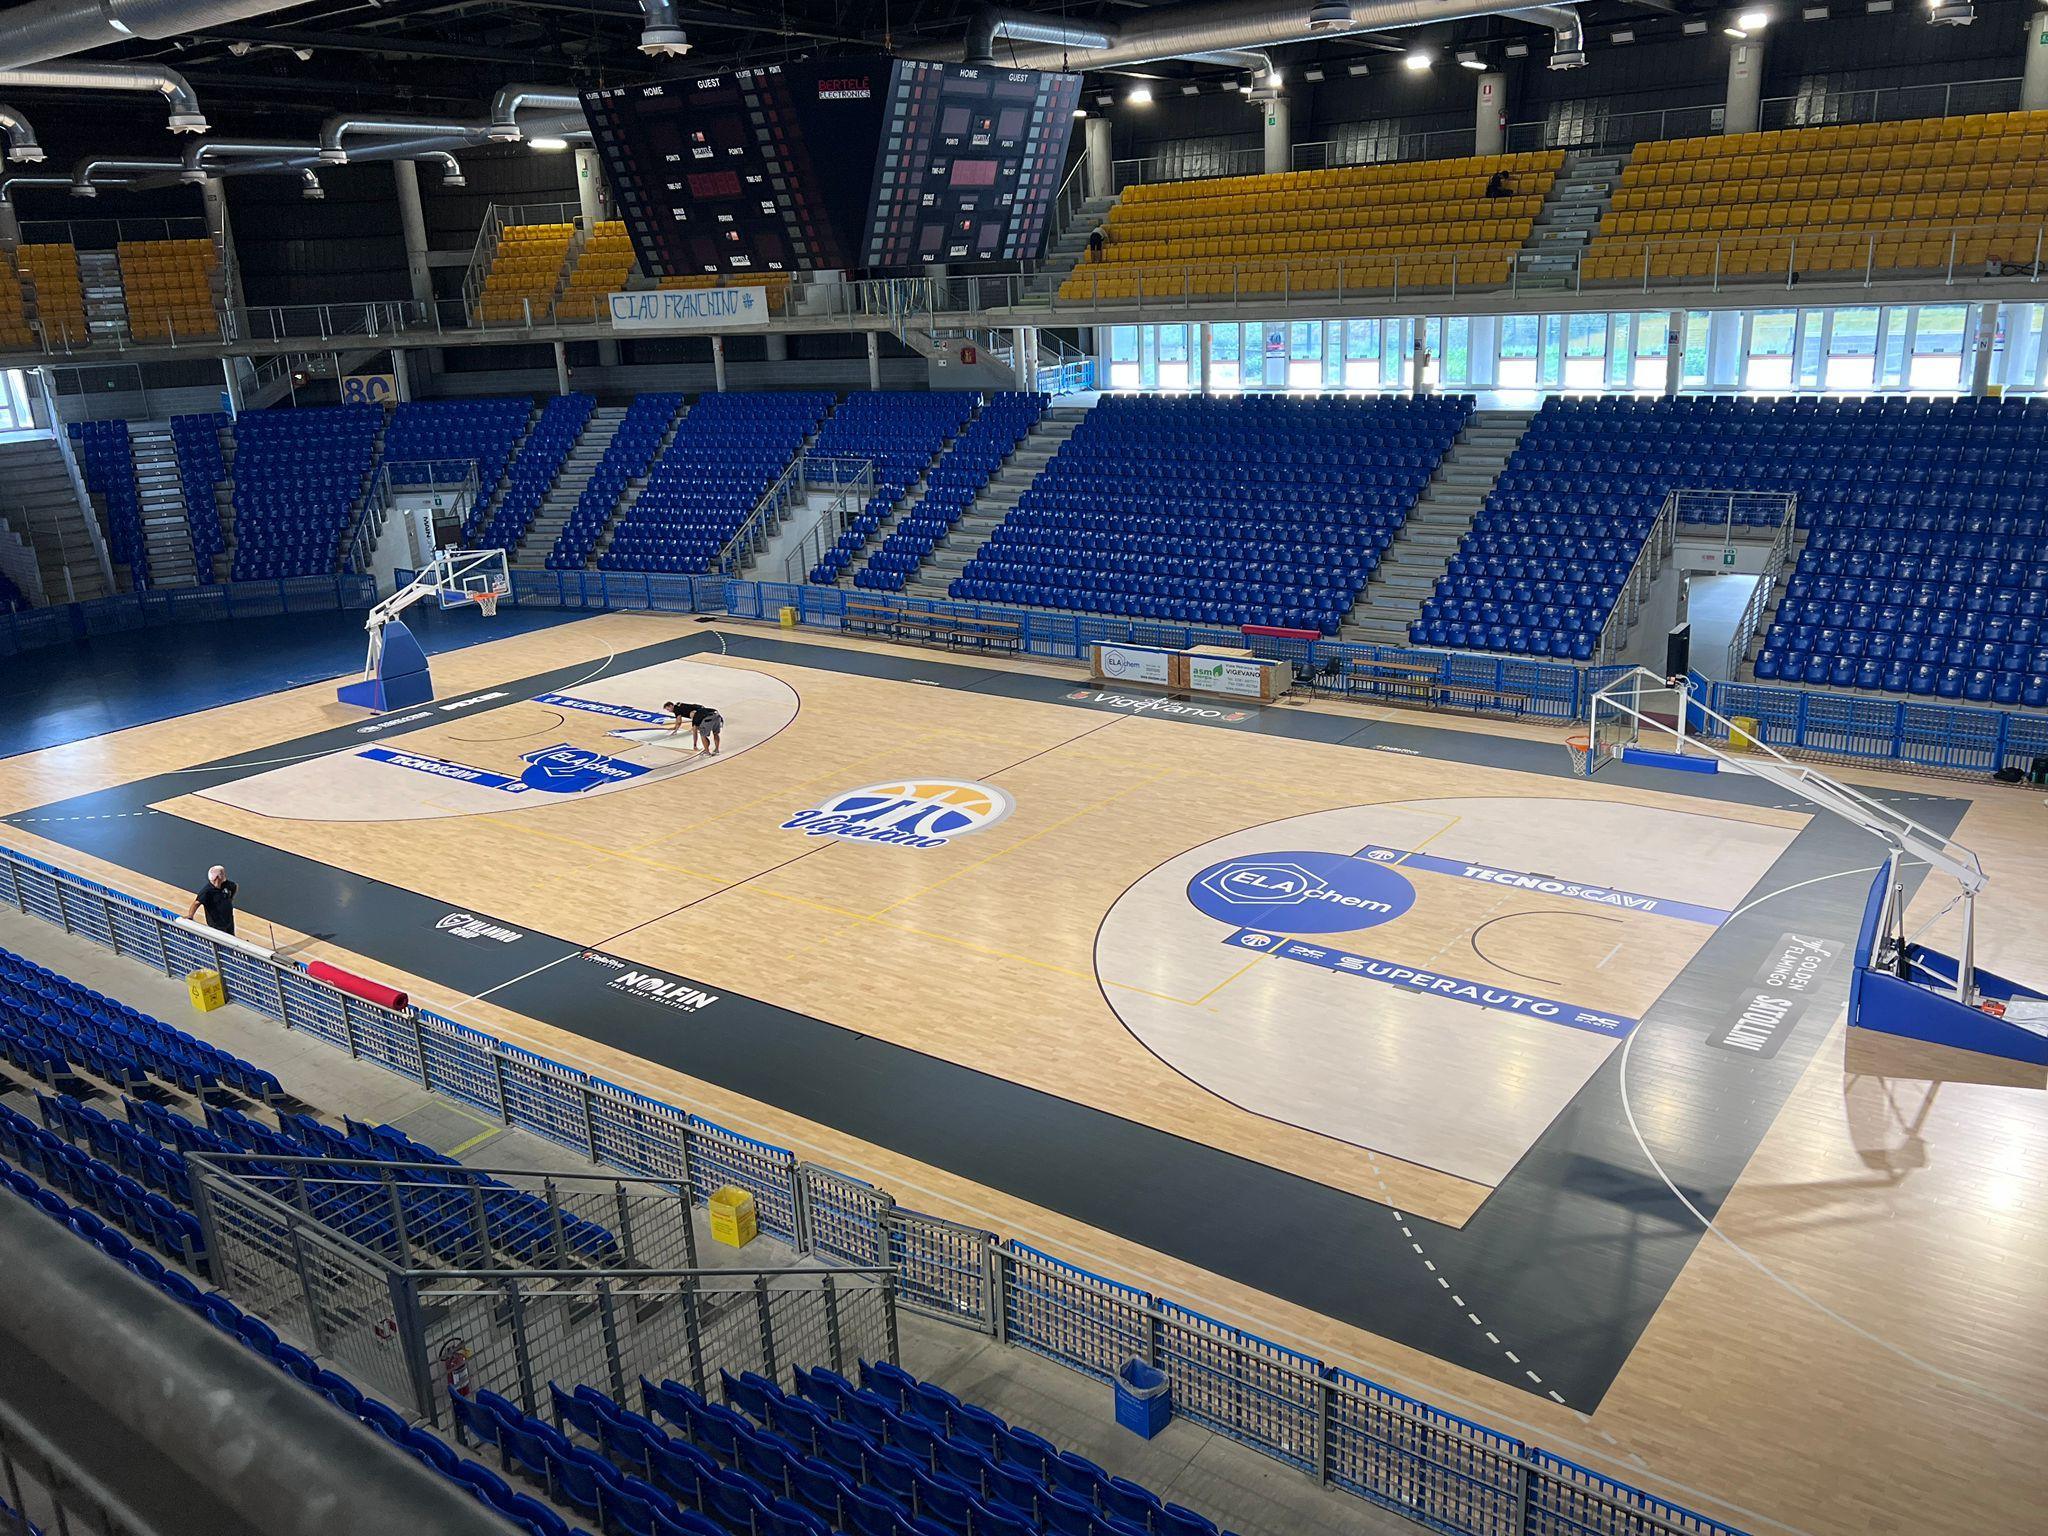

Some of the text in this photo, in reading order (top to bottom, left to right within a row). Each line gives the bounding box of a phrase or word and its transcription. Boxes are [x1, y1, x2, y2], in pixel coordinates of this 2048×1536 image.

[697, 78, 720, 89] GUEST
[960, 69, 978, 79] HOME
[1008, 73, 1028, 82] GUEST
[643, 86, 664, 96] HOME
[818, 90, 870, 99] ELECTRONICS
[612, 290, 738, 320] CIAO FRANCHINO
[1108, 658, 1121, 666] ELA
[1193, 667, 1212, 676] asm
[1225, 668, 1261, 678] VIGEVANO
[559, 699, 652, 720] SUPERAUTO
[386, 755, 483, 780] TECNOSCAVI
[552, 751, 632, 778] ELA chem
[780, 809, 949, 848] Vigevano
[1231, 871, 1392, 913] ELA chem
[1462, 866, 1660, 911] TECNOSCAVI
[1766, 945, 1804, 986] FLAMINGO
[1787, 955, 1822, 991] GOLDEN
[606, 981, 696, 1013] FULL RENT SOLUTIONS
[614, 970, 720, 1009] NOLFIN
[1334, 956, 1560, 1016] SUPERAUTO
[1722, 994, 1793, 1051] SATOLLINI
